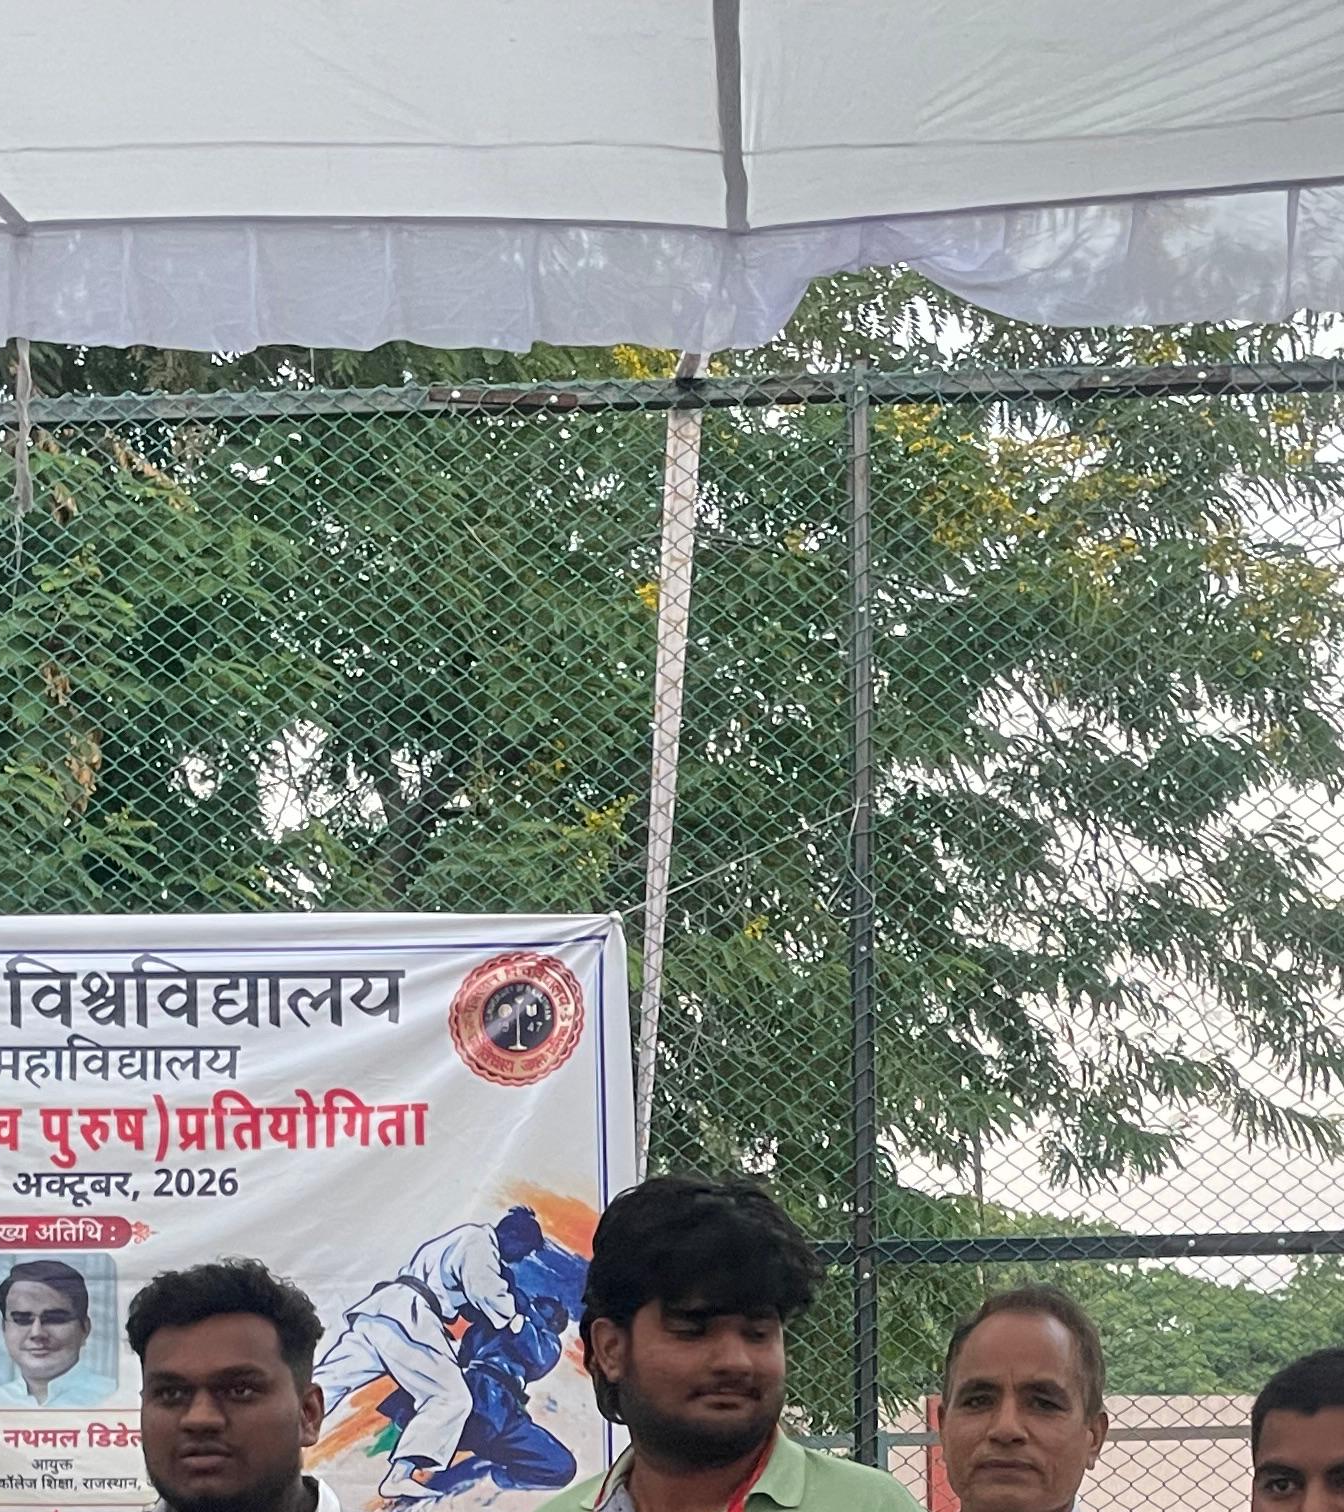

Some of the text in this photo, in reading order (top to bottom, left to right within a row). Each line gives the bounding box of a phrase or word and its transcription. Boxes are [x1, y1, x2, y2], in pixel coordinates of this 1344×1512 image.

[3, 953, 406, 1029] विश्वविद्यालय
[12, 1172, 140, 1208] अक्टूबर,
[153, 1167, 240, 1198] 2026
[35, 1217, 104, 1243] अतिथि
[3, 1428, 81, 1449] नथमल
[31, 1457, 74, 1475] आयुक्त
[41, 1474, 78, 1492] शिक्षा,
[82, 1477, 142, 1492] राजस्थान,
